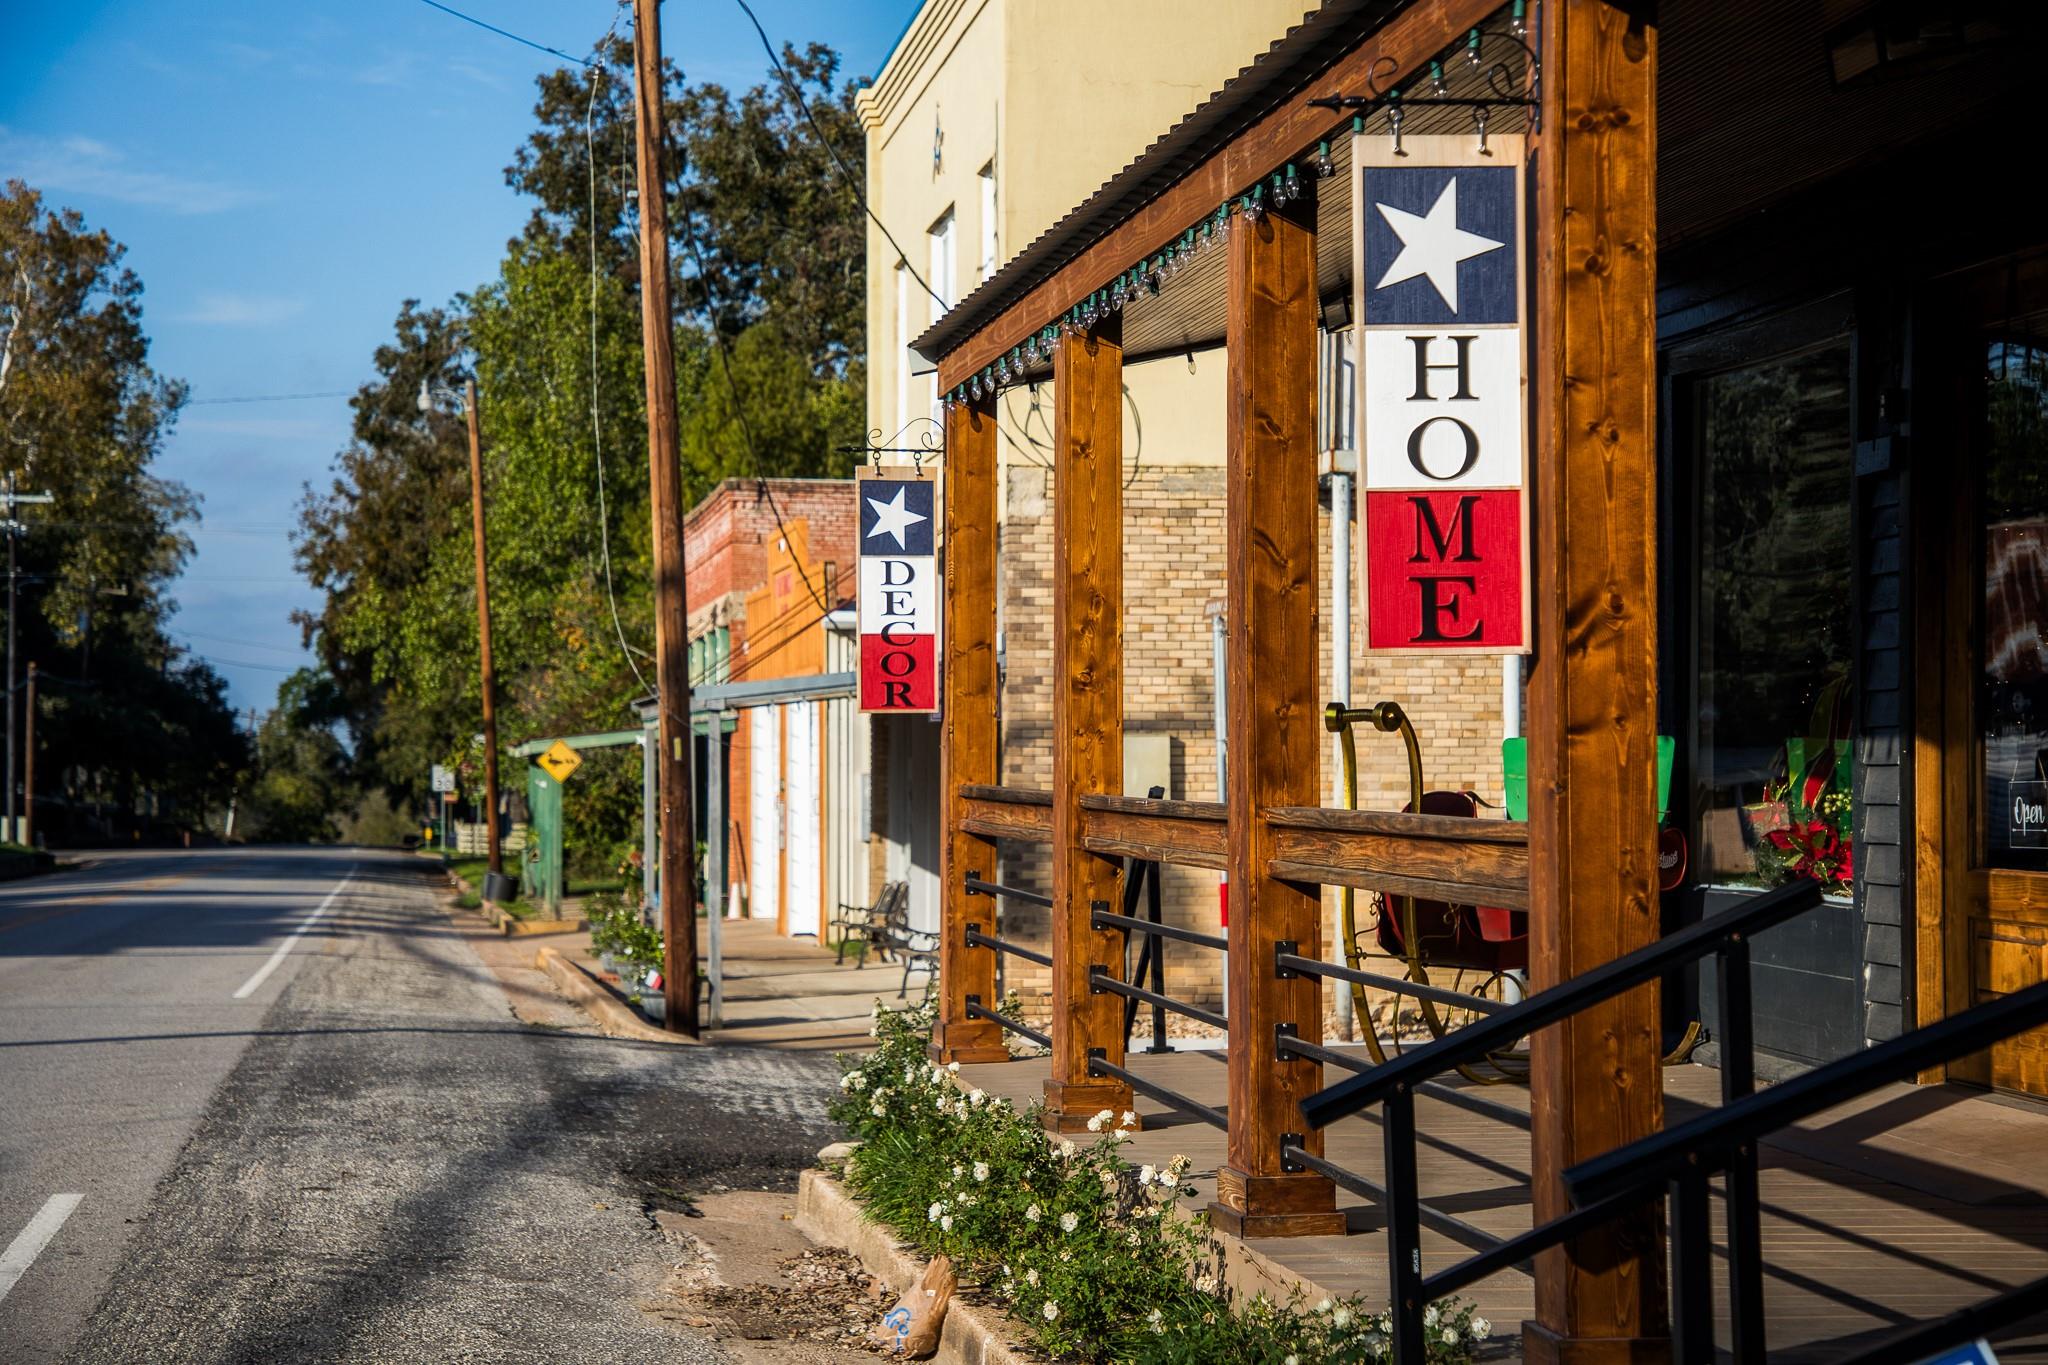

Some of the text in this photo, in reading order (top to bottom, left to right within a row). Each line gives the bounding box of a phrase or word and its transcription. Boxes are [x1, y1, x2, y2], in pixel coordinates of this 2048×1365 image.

[1405, 334, 1483, 643] HOME
[880, 560, 917, 707] DECOR
[2014, 796, 2046, 837] Open
